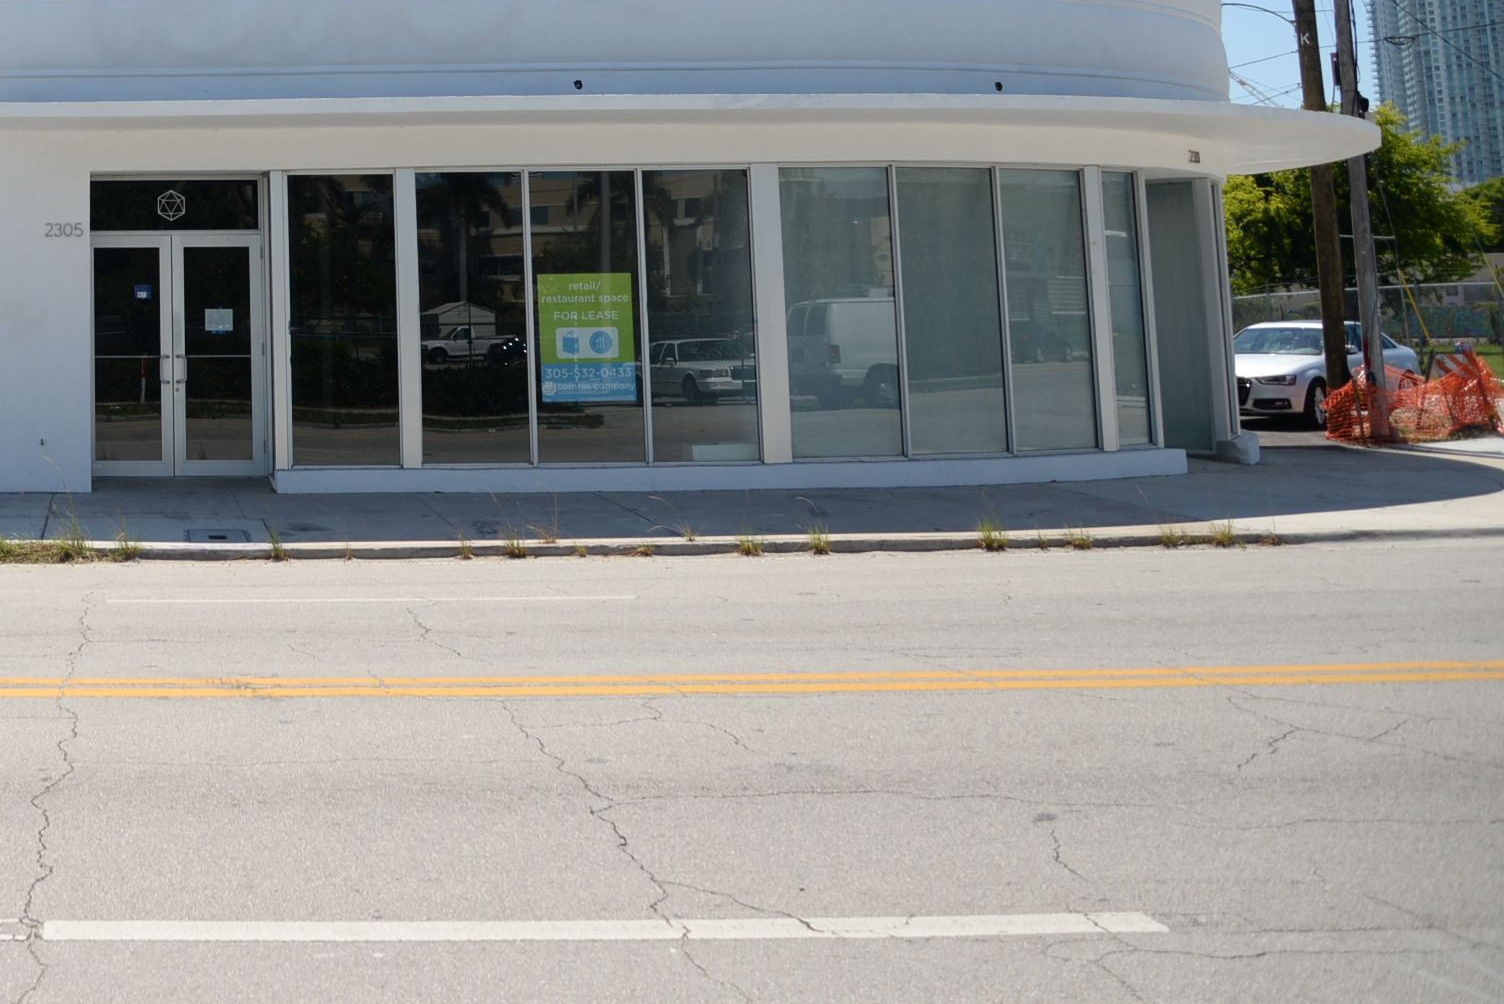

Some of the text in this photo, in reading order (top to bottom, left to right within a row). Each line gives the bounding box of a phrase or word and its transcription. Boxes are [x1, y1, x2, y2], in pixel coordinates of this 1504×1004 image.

[1300, 32, 1311, 45] K
[44, 222, 84, 237] 2305
[568, 281, 601, 291] retail/
[542, 294, 629, 304] restaurant space
[553, 310, 619, 321] FOR LEASE
[545, 367, 632, 379] 305-532-0433
[593, 382, 635, 392] company
